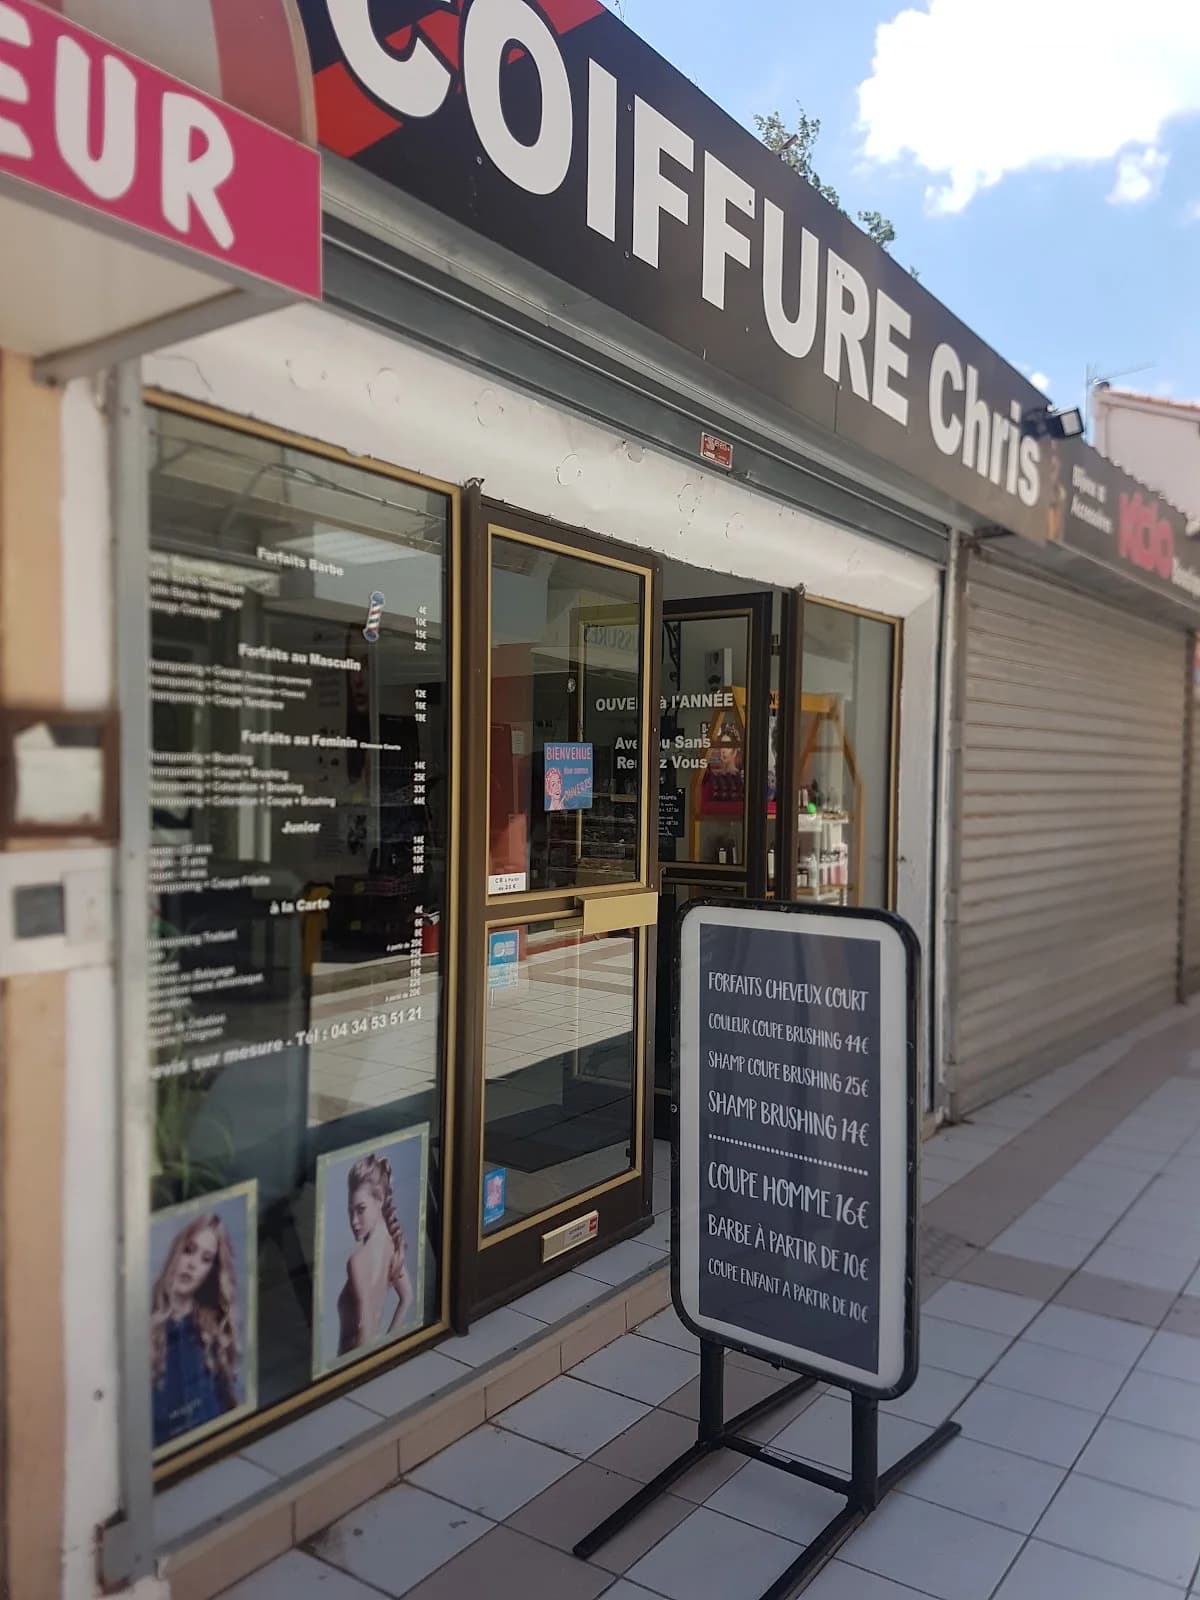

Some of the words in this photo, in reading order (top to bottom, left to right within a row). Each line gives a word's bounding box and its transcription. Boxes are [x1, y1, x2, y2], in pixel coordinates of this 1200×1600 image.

[323, 0, 912, 427] COIFFURE
[929, 343, 1040, 506] Chris
[257, 546, 306, 570] Forfaits
[309, 558, 344, 577] Barbe
[238, 642, 289, 664] Forfaits
[291, 653, 308, 666] au
[310, 653, 361, 672] Masculin
[671, 690, 733, 709] l'ANNÉE
[241, 729, 291, 746] Forfaits
[293, 734, 310, 748] au
[547, 746, 592, 761] BIENVENUE
[675, 736, 711, 749] Sans
[672, 755, 708, 769] Vous
[282, 820, 321, 834] Junior
[281, 899, 293, 913] la
[296, 898, 331, 911] Carte
[708, 971, 762, 996] FORFAITS
[765, 979, 822, 1005] CHEVEUX
[825, 986, 869, 1012] COURT
[223, 1037, 283, 1064] mesure
[331, 1022, 347, 1039] 04
[351, 1017, 367, 1034] 34
[371, 1014, 386, 1030] 53
[390, 1009, 404, 1025] 51
[408, 1005, 422, 1021] 21
[708, 1012, 751, 1034] COULEUR
[752, 1019, 784, 1040] COUPE
[786, 1025, 842, 1050] BRUSHING
[845, 1034, 869, 1054] 44€
[708, 1050, 745, 1073] SHAMP
[747, 1057, 781, 1080] COUPE
[783, 1064, 842, 1092] BRUSHING
[844, 1076, 869, 1097] 25€
[708, 1090, 757, 1120] SHAMP
[761, 1101, 837, 1140] BRUSHING
[841, 1118, 869, 1147] 14€
[708, 1161, 759, 1199] COUPE
[763, 1175, 831, 1219] HOMME
[836, 1193, 869, 1229] 16€
[708, 1213, 752, 1246] BARBE
[754, 1223, 766, 1250] À
[769, 1230, 818, 1266] PARTIR
[821, 1245, 841, 1272] DE
[844, 1252, 869, 1281] 10€
[708, 1257, 738, 1282] COUPE
[740, 1264, 781, 1294] ENFANT
[782, 1281, 791, 1298] A
[793, 1283, 831, 1311] PARTIR
[832, 1296, 847, 1317] DE
[849, 1301, 869, 1323] 10€
